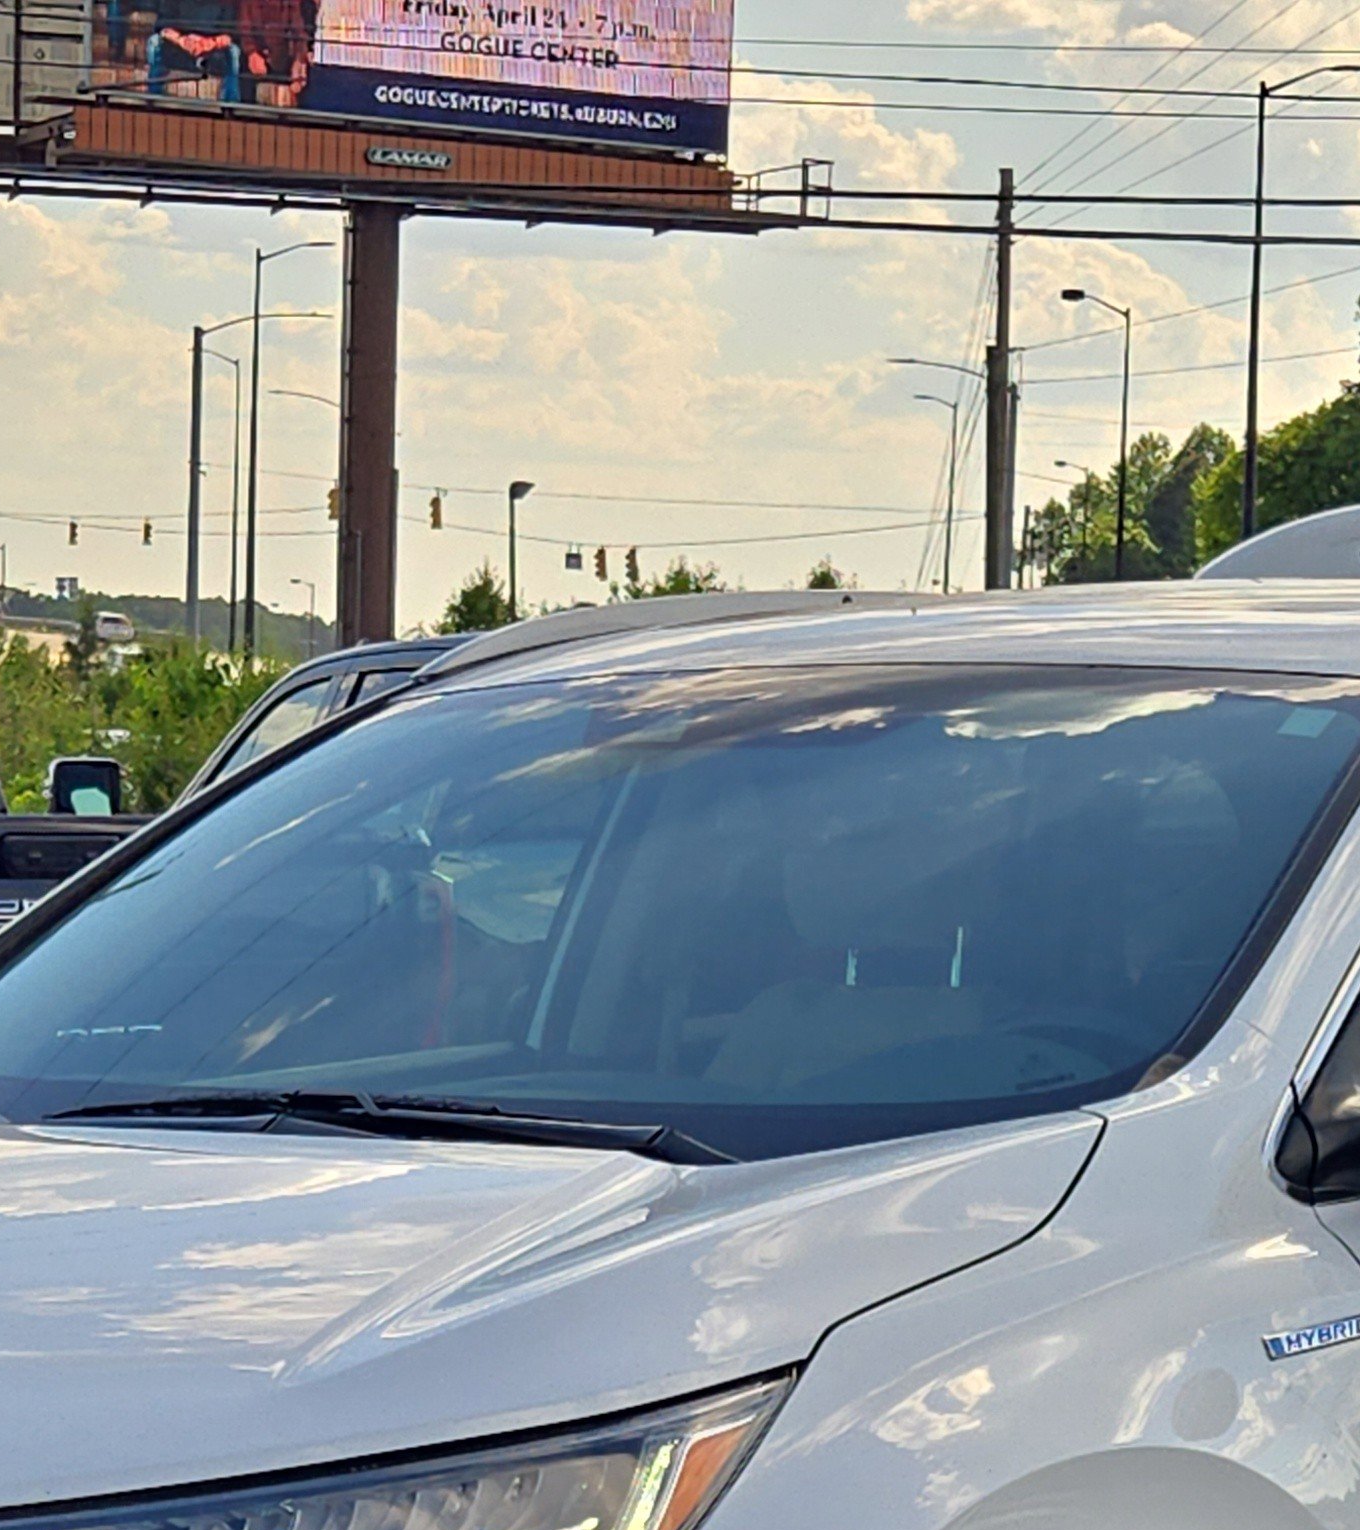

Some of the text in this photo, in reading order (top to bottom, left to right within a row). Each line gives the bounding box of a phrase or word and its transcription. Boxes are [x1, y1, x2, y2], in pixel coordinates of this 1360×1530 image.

[440, 31, 619, 69] GOGUE CENTER
[371, 148, 449, 168] LAMAR
